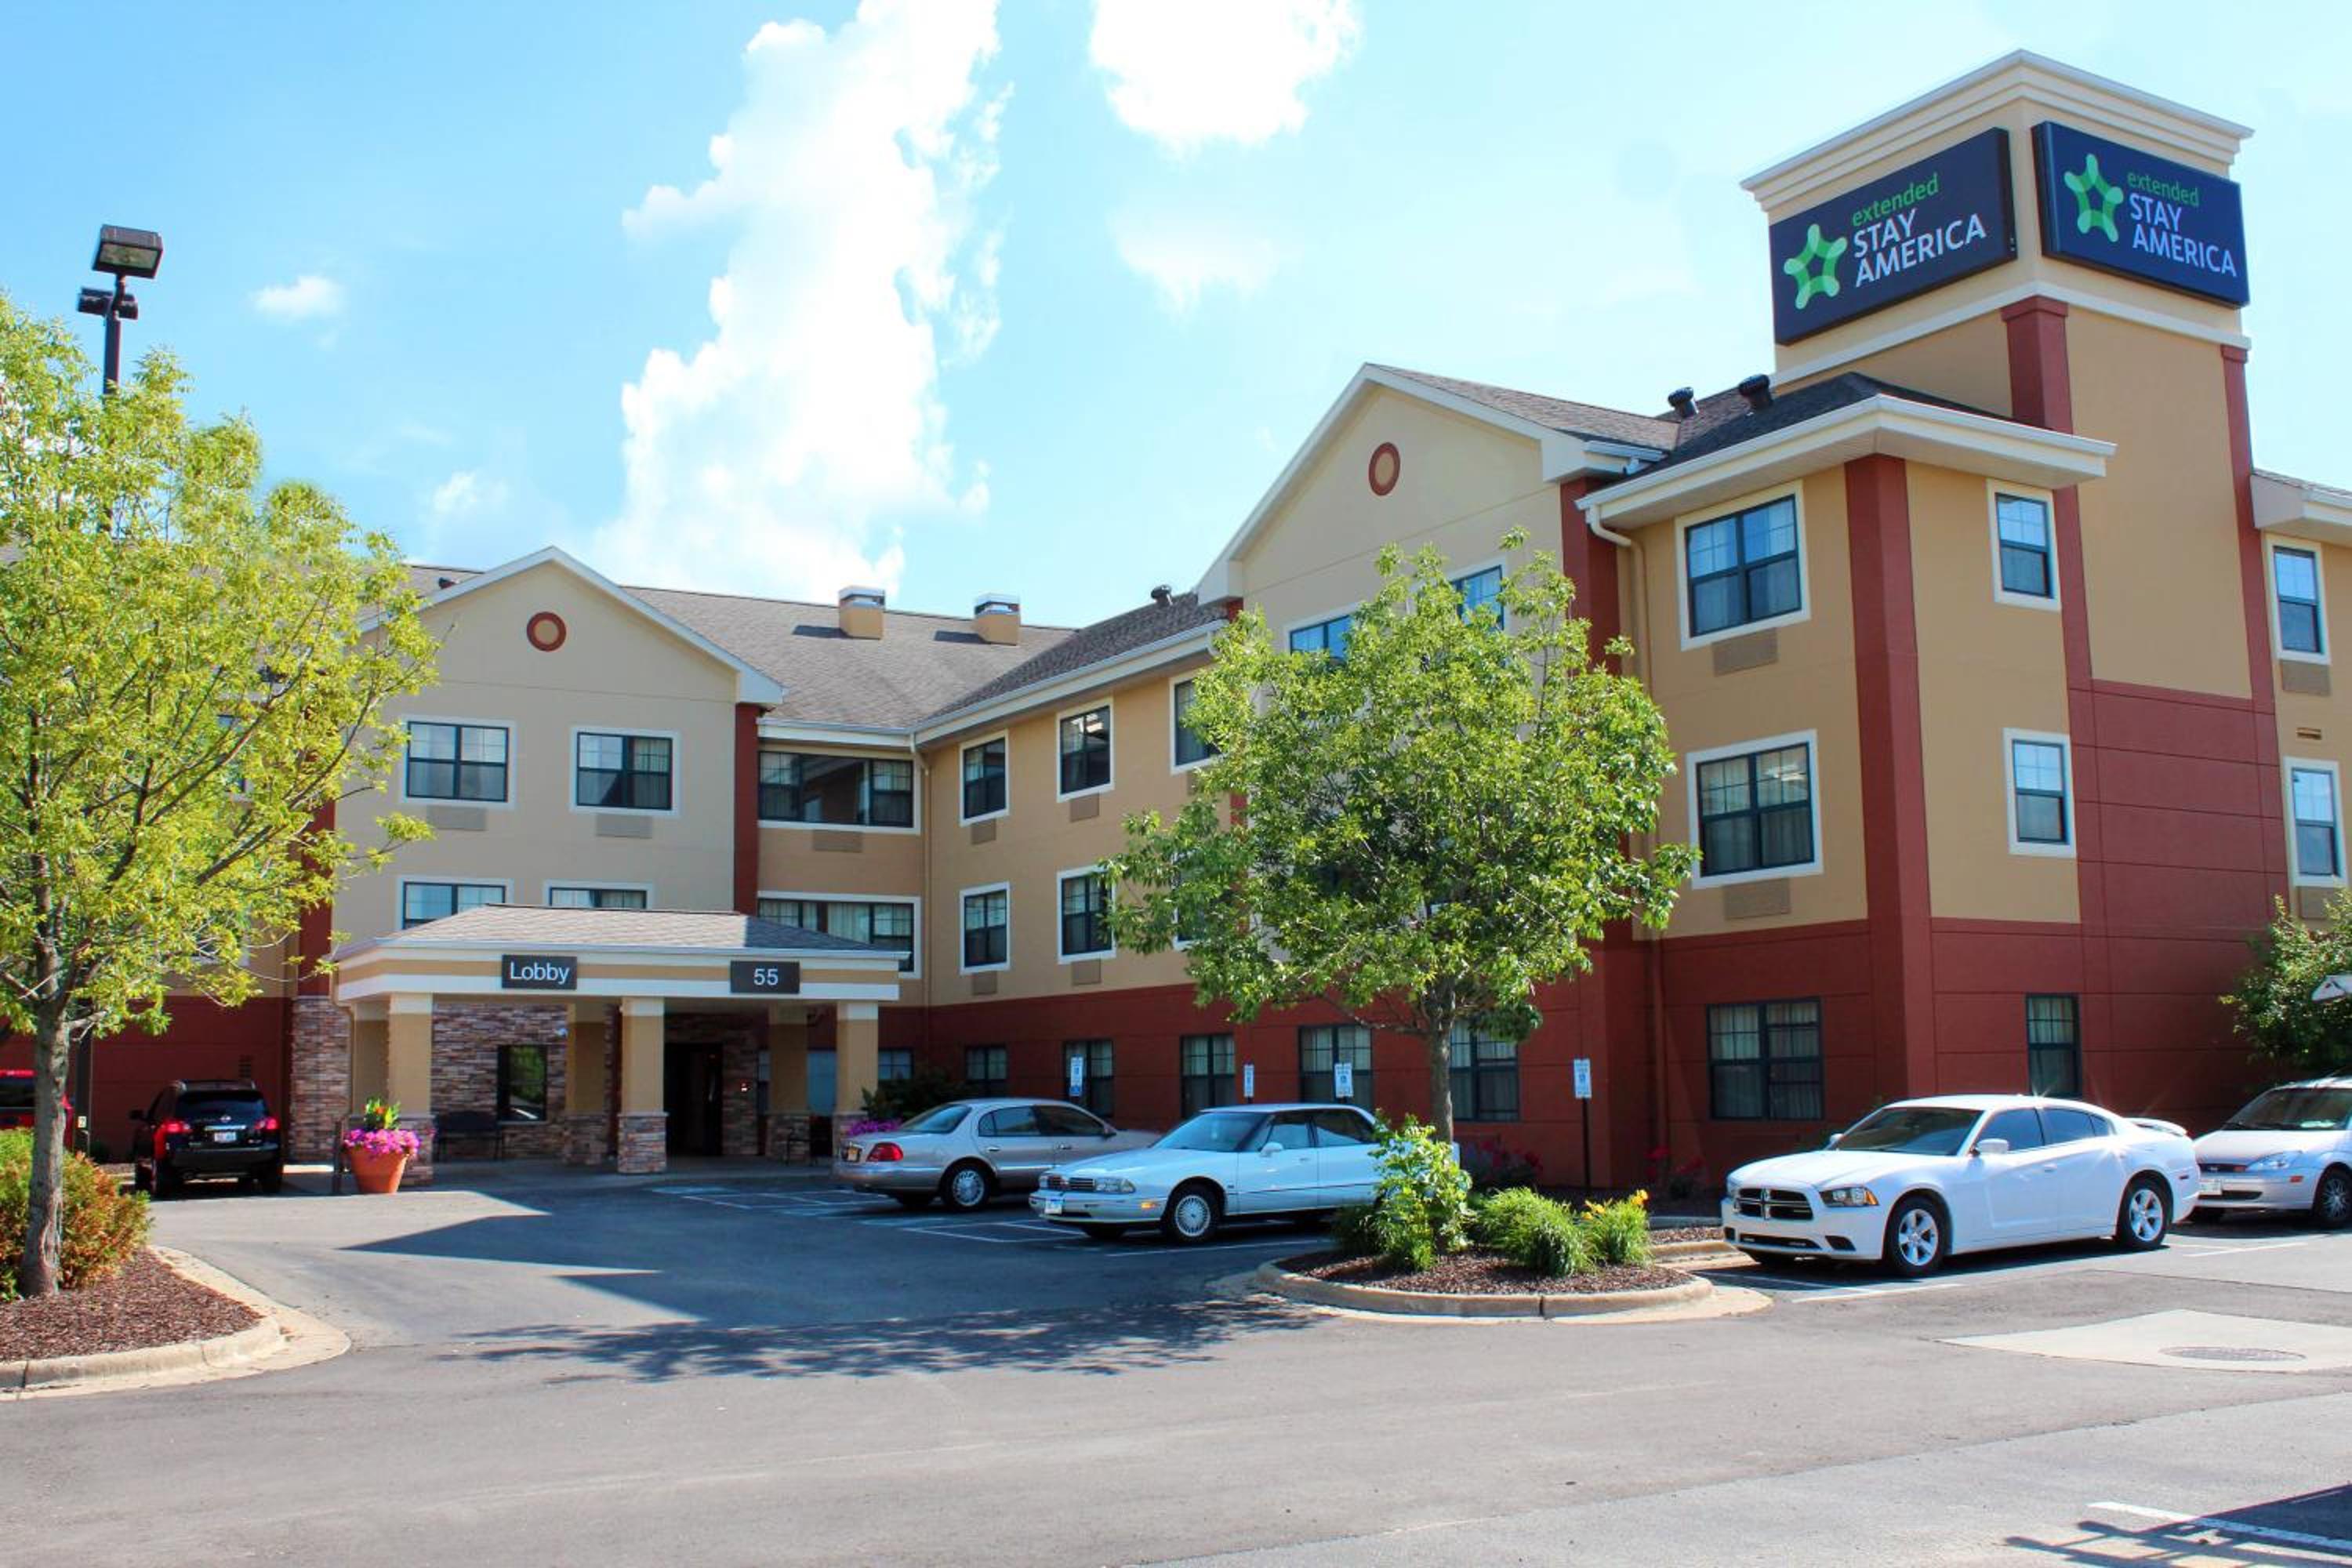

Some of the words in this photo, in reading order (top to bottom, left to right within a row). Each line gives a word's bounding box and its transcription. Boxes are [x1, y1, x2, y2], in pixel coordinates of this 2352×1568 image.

[1852, 172, 1939, 227] extended
[2127, 172, 2199, 207] extended
[2129, 192, 2182, 233] STAY
[1853, 208, 1917, 259] STAY
[1856, 212, 1987, 288] AMERICA
[2132, 223, 2237, 278] AMERICA
[510, 962, 570, 985] Lobby
[753, 968, 779, 986] 55
